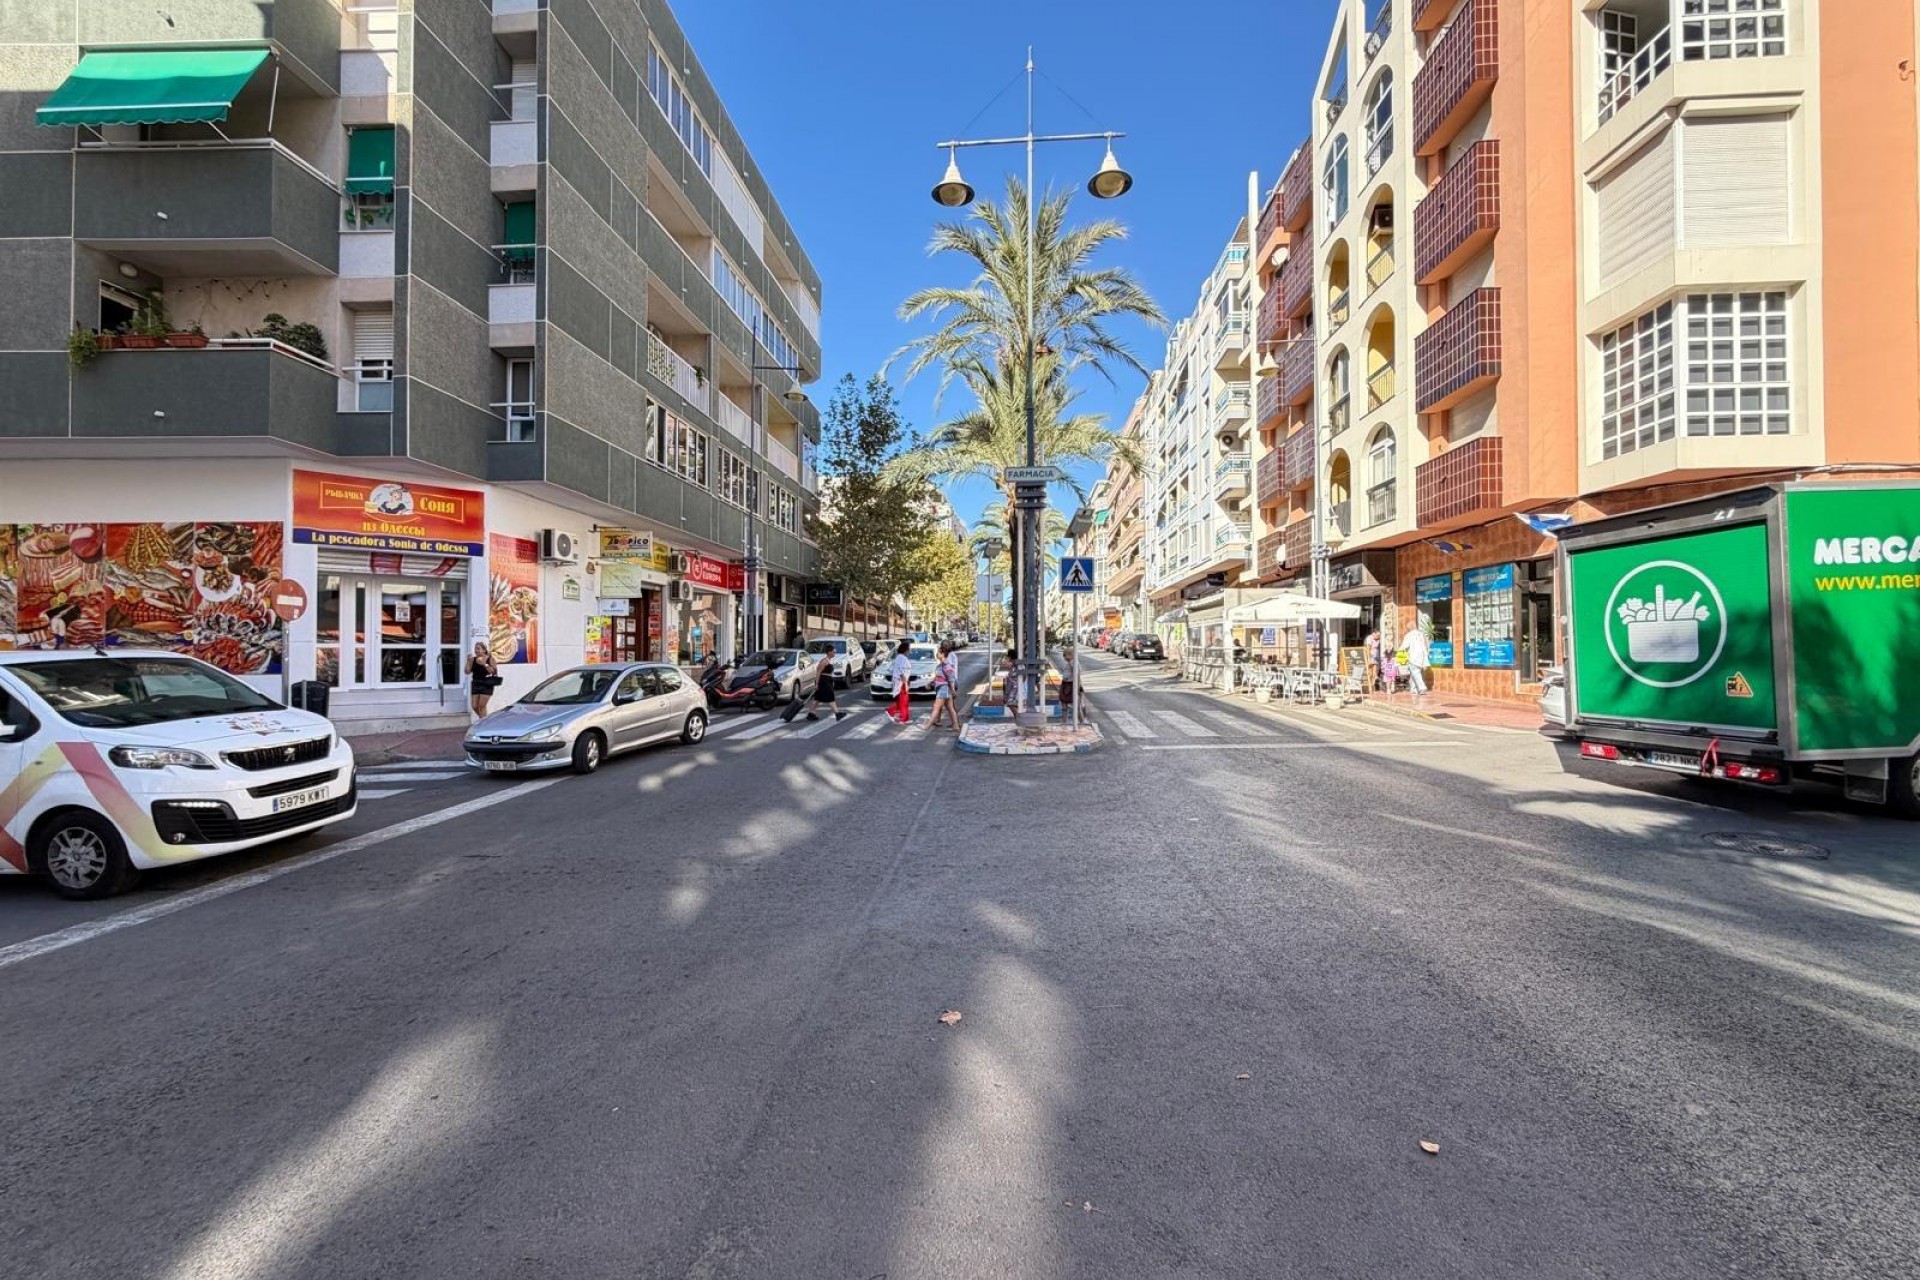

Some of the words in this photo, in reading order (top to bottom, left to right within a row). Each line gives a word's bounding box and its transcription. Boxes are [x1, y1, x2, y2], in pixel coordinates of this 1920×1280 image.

[1007, 469, 1053, 479] FARMACIA
[419, 496, 455, 514] Соня
[311, 531, 326, 543] La
[328, 534, 385, 547] pescadora
[388, 538, 417, 550] Sonia
[420, 540, 433, 551] de
[435, 542, 469, 554] Odessa
[279, 795, 306, 809] 5979
